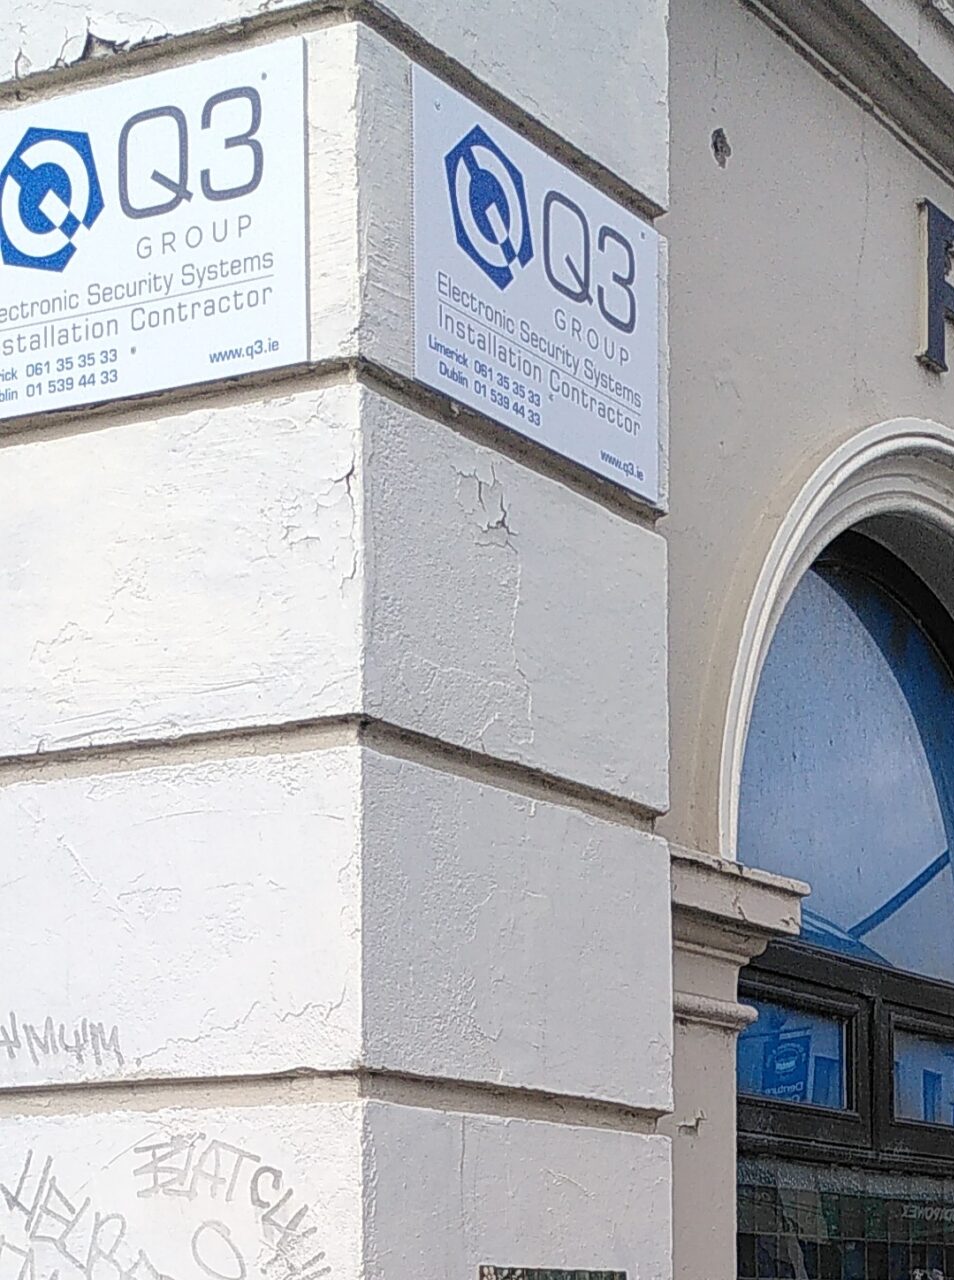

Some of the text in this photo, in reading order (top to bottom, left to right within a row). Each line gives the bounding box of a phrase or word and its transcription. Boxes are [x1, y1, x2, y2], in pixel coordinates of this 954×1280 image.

[118, 85, 264, 220] Q3
[136, 214, 252, 260] GROUP
[543, 190, 637, 334] Q3
[0, 251, 275, 324] ectronic Security Systems
[2, 286, 273, 356] stallation Contractor
[26, 360, 50, 378] 061
[56, 356, 74, 372] 35
[78, 352, 95, 369] 35
[100, 348, 118, 365] 33
[209, 338, 280, 363] www.q3.ie
[428, 334, 541, 407] Limerick 061 35 35 33
[437, 271, 642, 408] Electronic Security Systems
[439, 304, 641, 436] Installation Contractor
[554, 308, 630, 367] GROUP
[26, 382, 42, 397] 01
[48, 376, 74, 394] 539
[78, 373, 96, 388] 44
[100, 369, 118, 385] 33
[439, 361, 541, 426] Dublin 01 539 44 33
[600, 449, 644, 481] www.q3.ie
